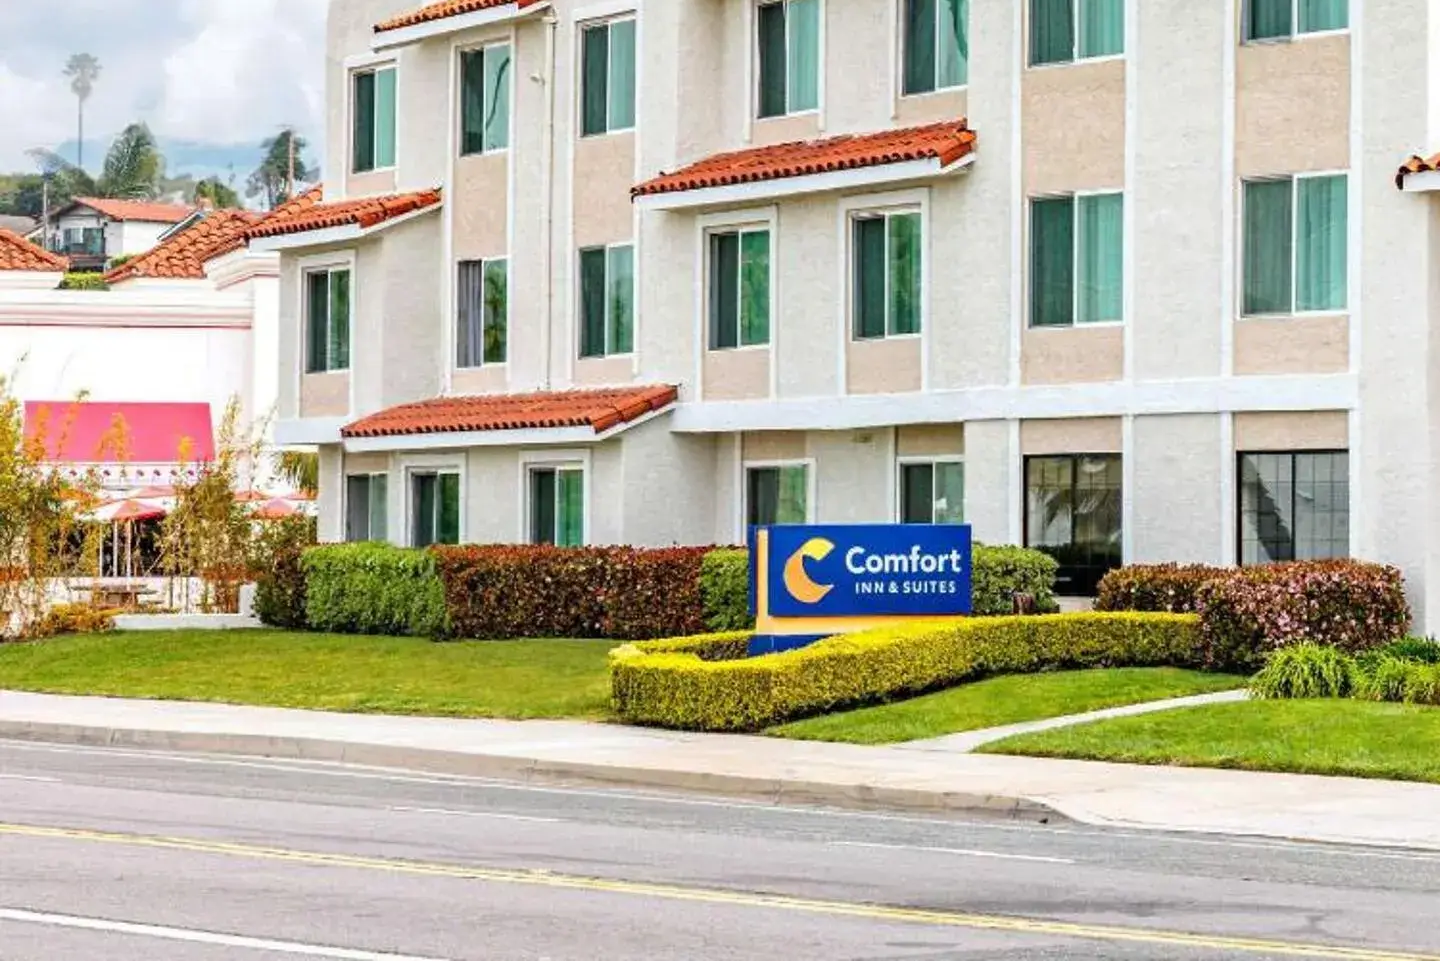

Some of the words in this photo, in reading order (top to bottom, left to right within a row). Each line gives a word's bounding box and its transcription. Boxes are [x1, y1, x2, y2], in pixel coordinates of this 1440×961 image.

[845, 544, 962, 575] Comfort
[855, 581, 884, 594] INN
[888, 581, 899, 594] &
[903, 580, 956, 594] SUITES
